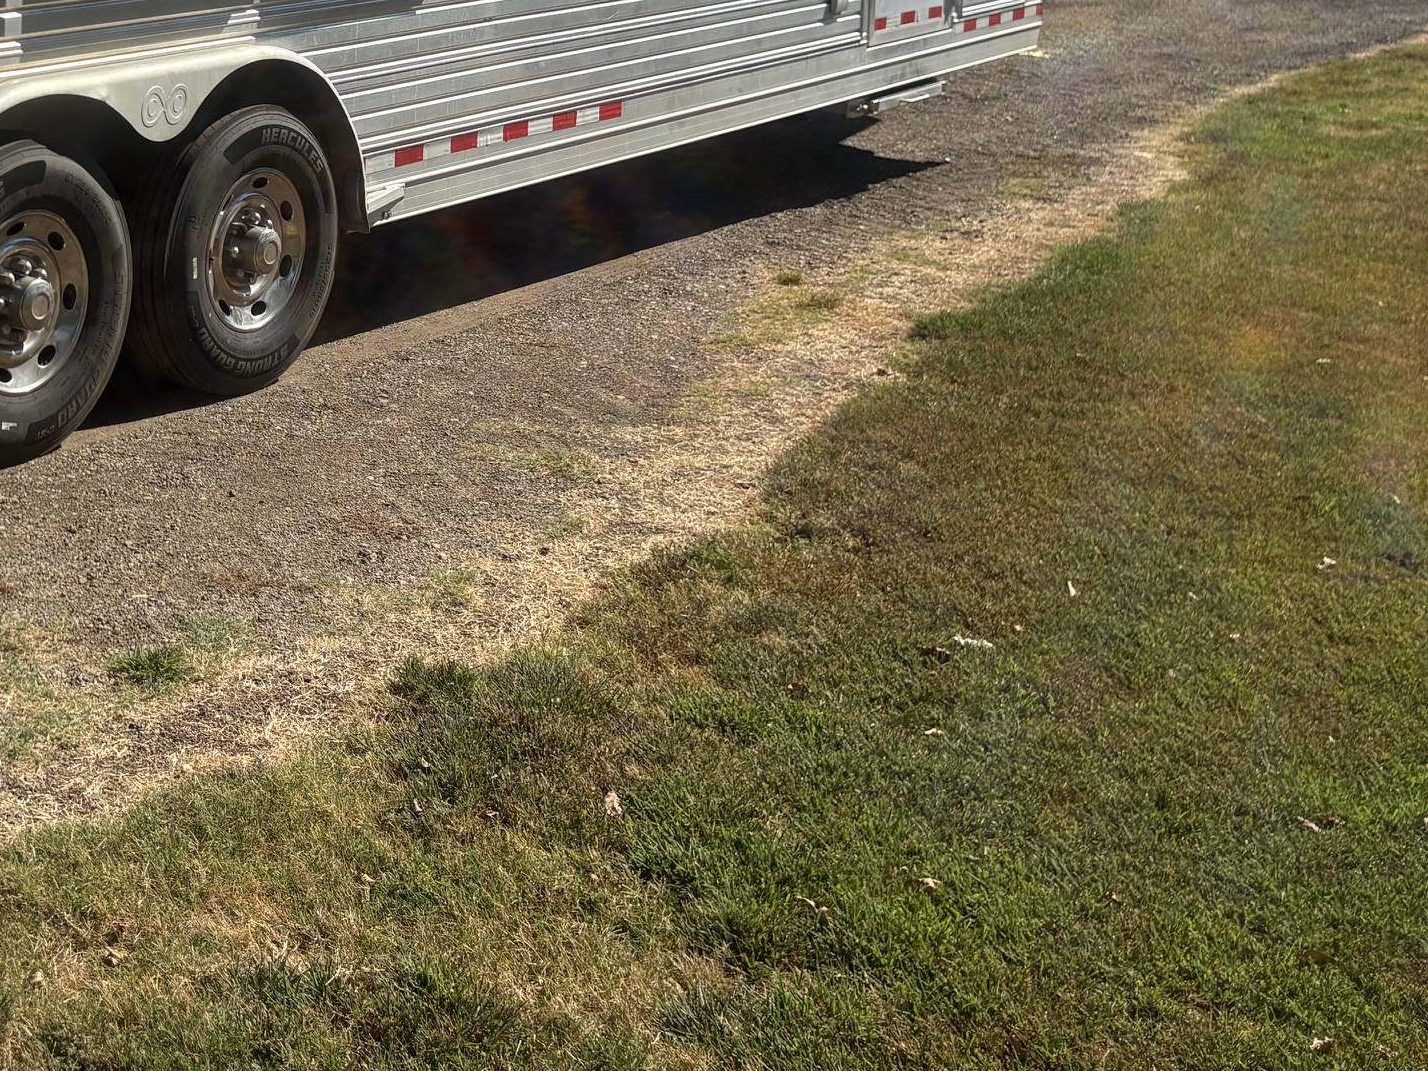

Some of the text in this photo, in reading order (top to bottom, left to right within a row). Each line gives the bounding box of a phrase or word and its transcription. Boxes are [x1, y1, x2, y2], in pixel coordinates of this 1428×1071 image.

[261, 127, 324, 174] HERCULES
[197, 326, 236, 371] GUARD
[234, 344, 288, 376] STRONG
